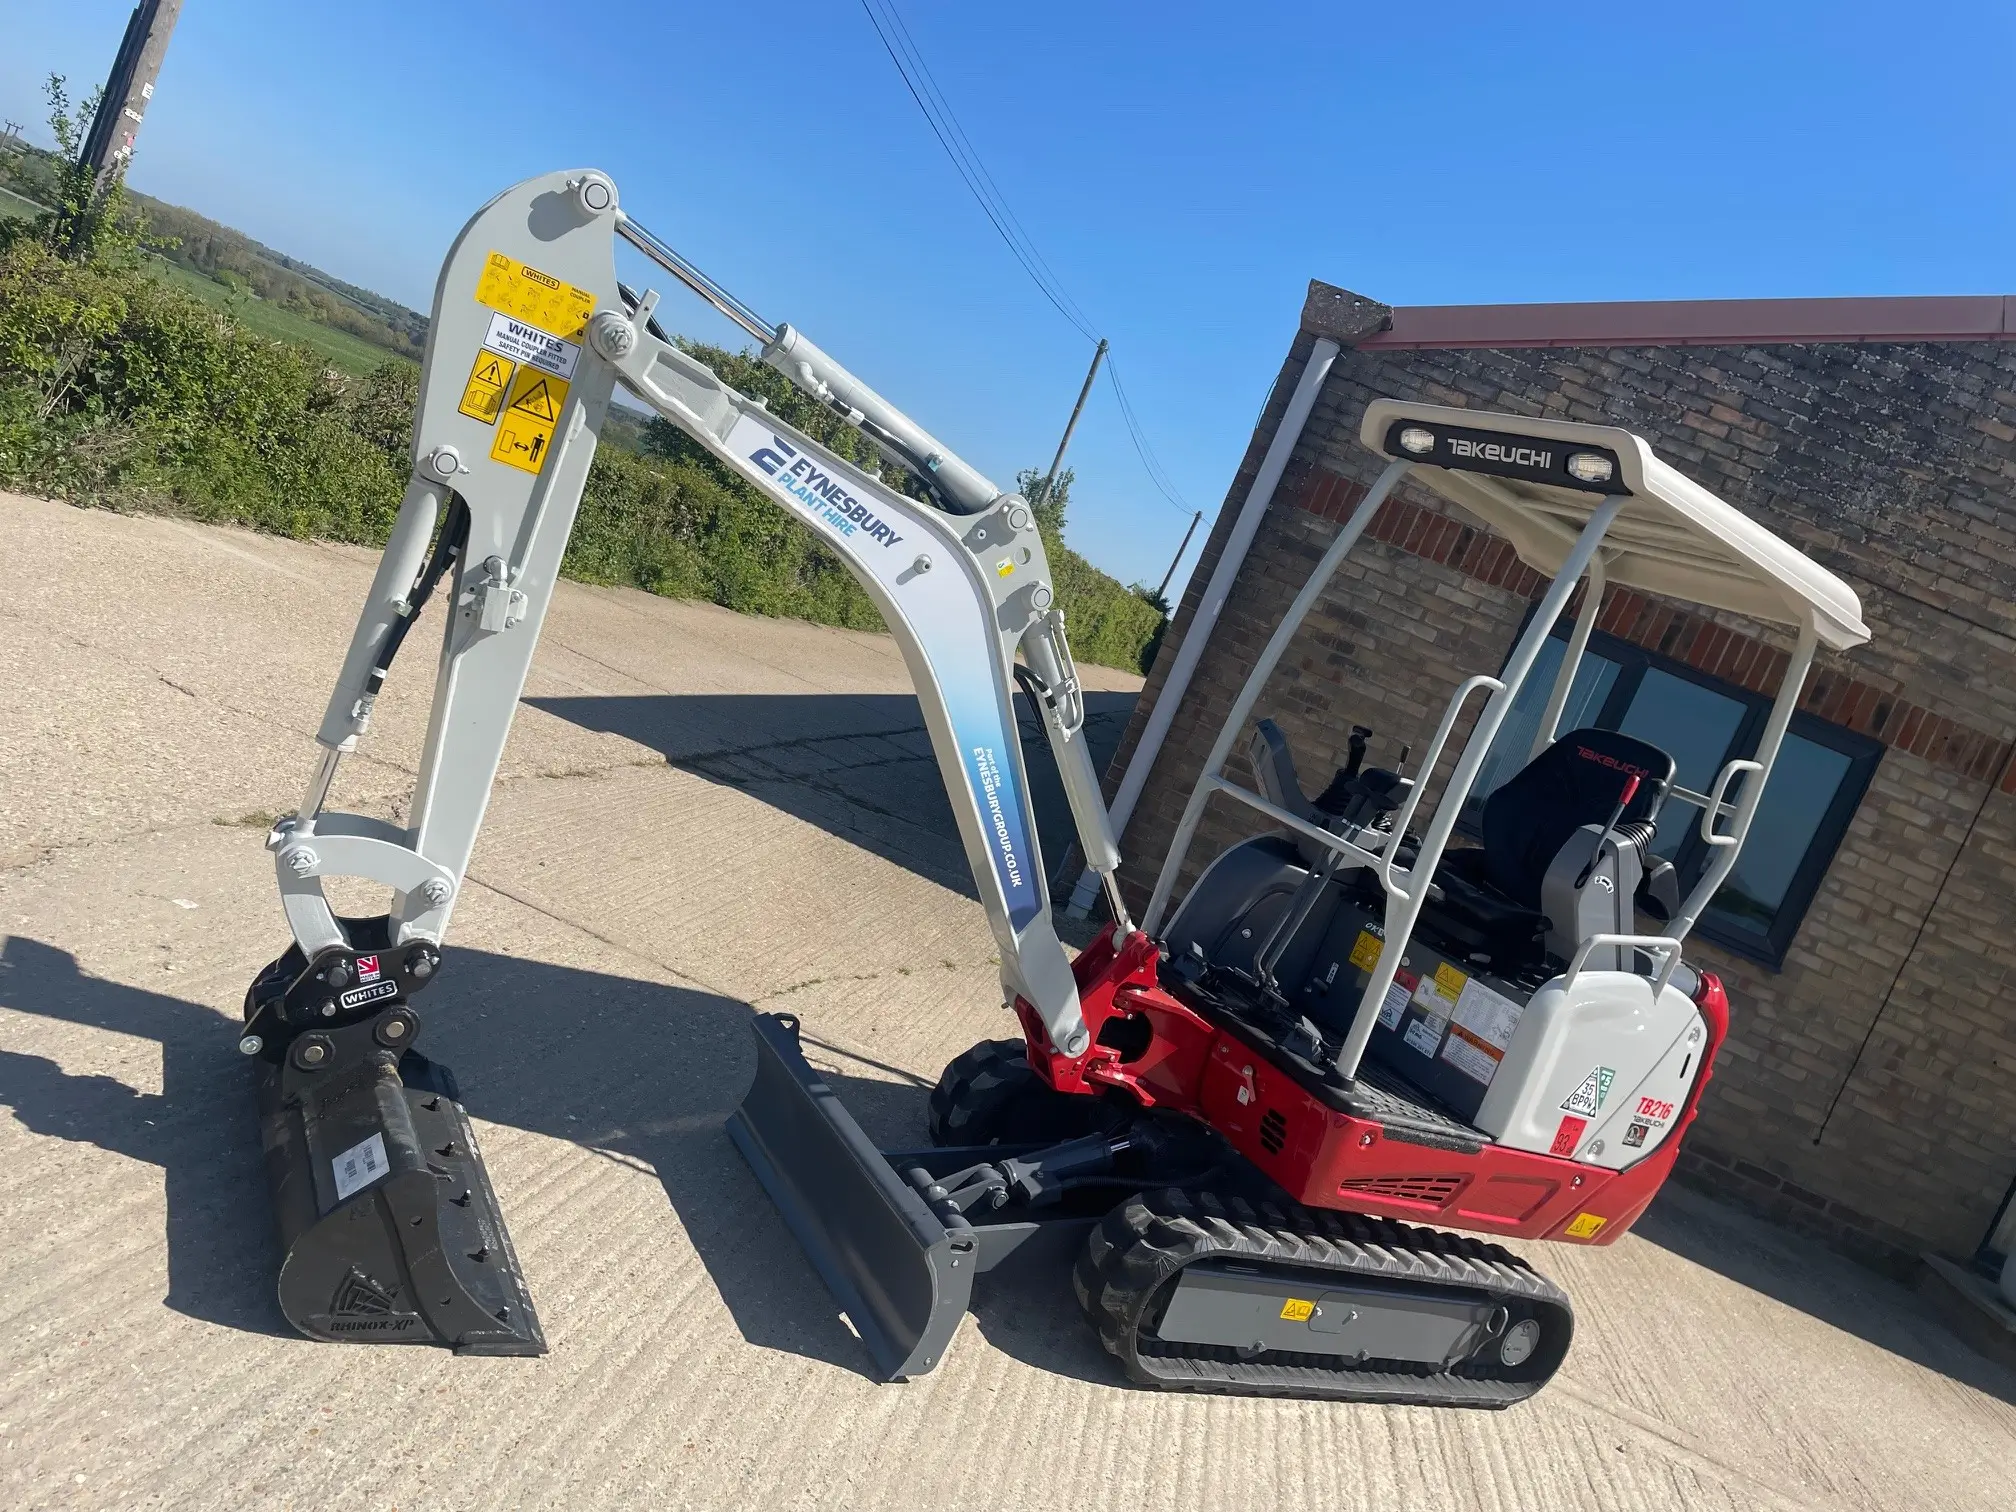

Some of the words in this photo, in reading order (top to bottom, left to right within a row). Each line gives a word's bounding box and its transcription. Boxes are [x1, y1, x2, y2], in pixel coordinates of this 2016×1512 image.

[525, 269, 557, 287] WHITES
[496, 331, 520, 345] MANUAL
[521, 341, 549, 357] COUPLER
[548, 351, 567, 365] FITTED
[508, 321, 564, 353] WHITES
[498, 340, 520, 355] SAFETY
[520, 349, 531, 359] PIN
[531, 354, 560, 371] REQUIRED
[1447, 438, 1551, 469] TAKEUCHI
[777, 472, 828, 511] PLANT
[821, 507, 857, 537] HIRE
[789, 458, 903, 548] EYNESBURY
[985, 748, 996, 766] Part
[993, 774, 1001, 788] the
[1577, 745, 1650, 779] TAKEUCHI
[973, 746, 1023, 888] EYNESBURYGROUP.CO.UK
[345, 984, 393, 1004] WHITES
[1582, 1082, 1595, 1096] 35
[1633, 1115, 1665, 1128] TAKEUCHI
[1636, 1097, 1674, 1120] TB216
[1554, 1133, 1570, 1152] 93
[329, 1319, 415, 1332] RHINOX-XP
